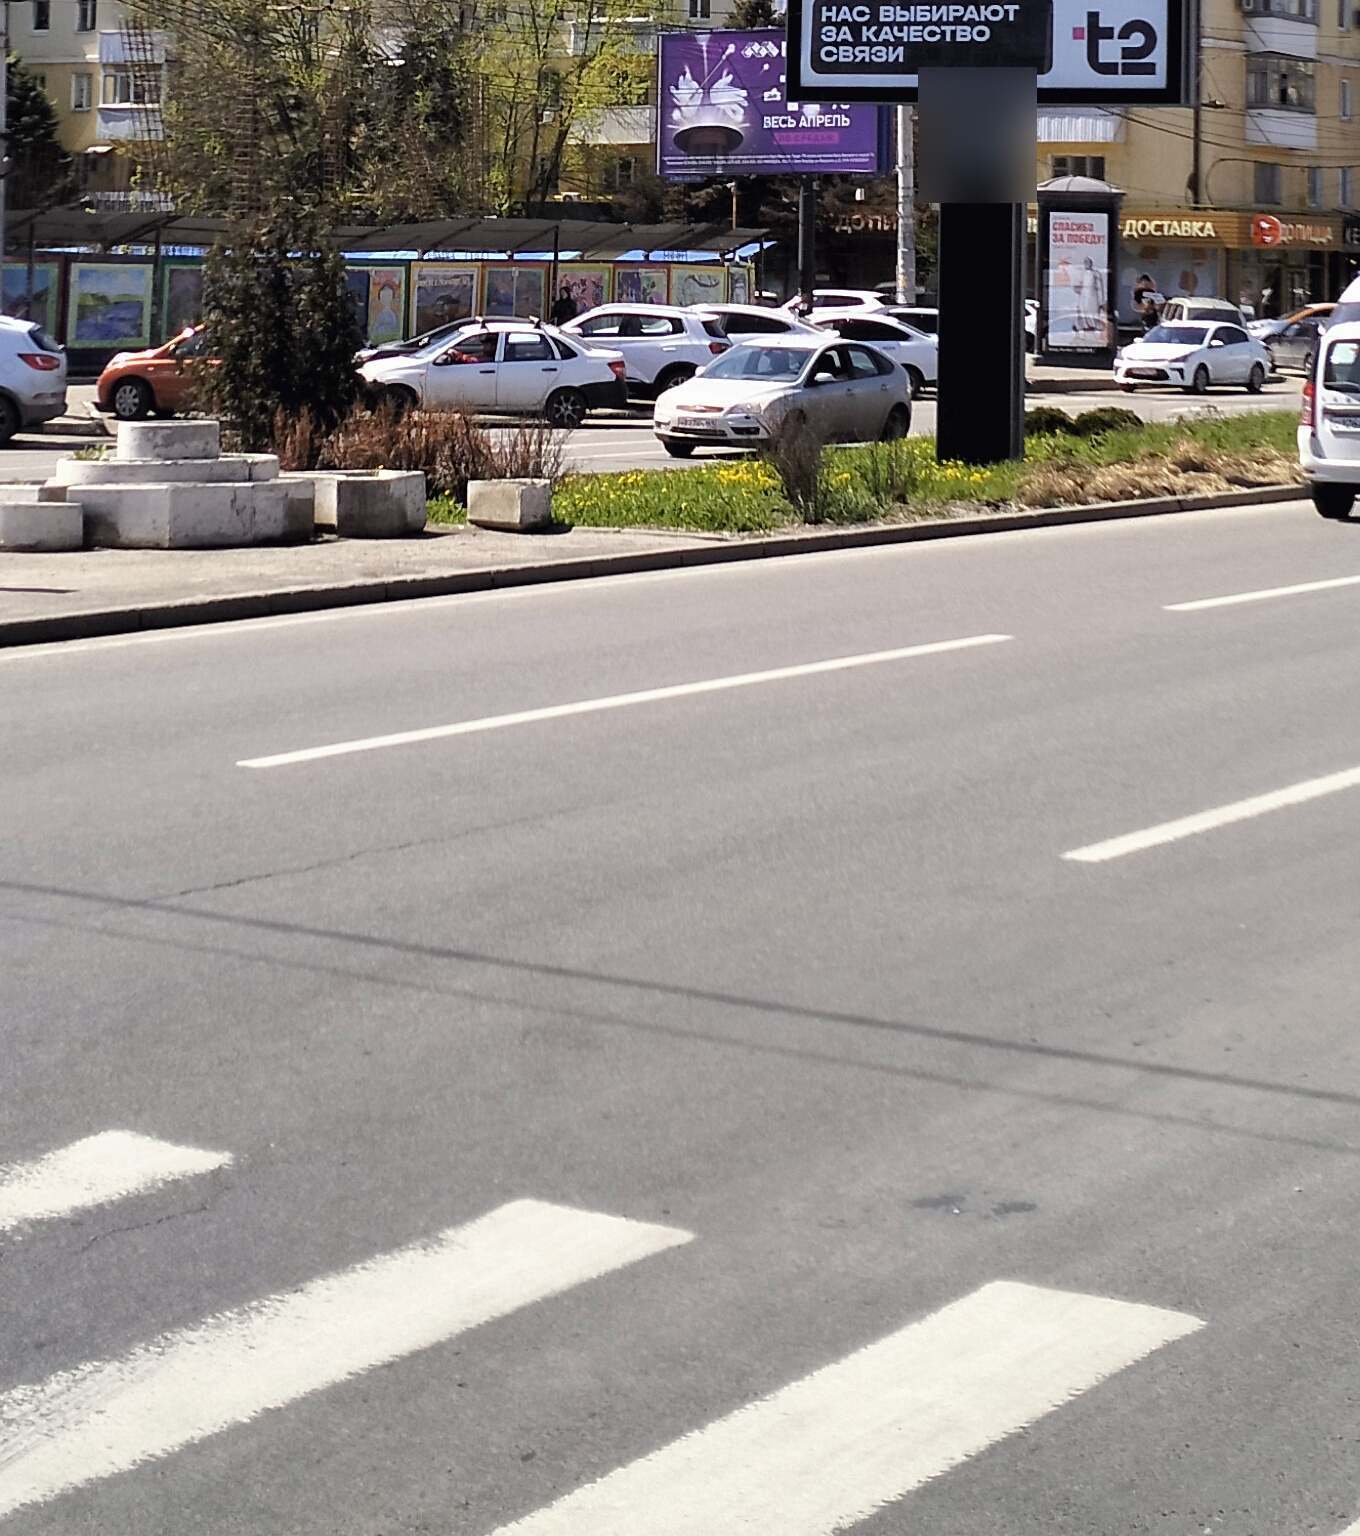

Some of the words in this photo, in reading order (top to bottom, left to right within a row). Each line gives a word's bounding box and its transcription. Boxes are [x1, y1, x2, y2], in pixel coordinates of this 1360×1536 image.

[820, 4, 871, 23] НАС
[879, 4, 1020, 23] ВЫБИРАЮТ
[820, 24, 857, 42] ЗА
[862, 24, 991, 43] КАЧЕСТВО
[1086, 10, 1157, 76] t2
[819, 45, 905, 63] СВЯЗИ
[763, 116, 797, 129] ВЕСЬ
[798, 114, 850, 128] АПРЕЛЬ
[1052, 222, 1094, 232] СПАСИБО
[1052, 233, 1065, 243] ЗА
